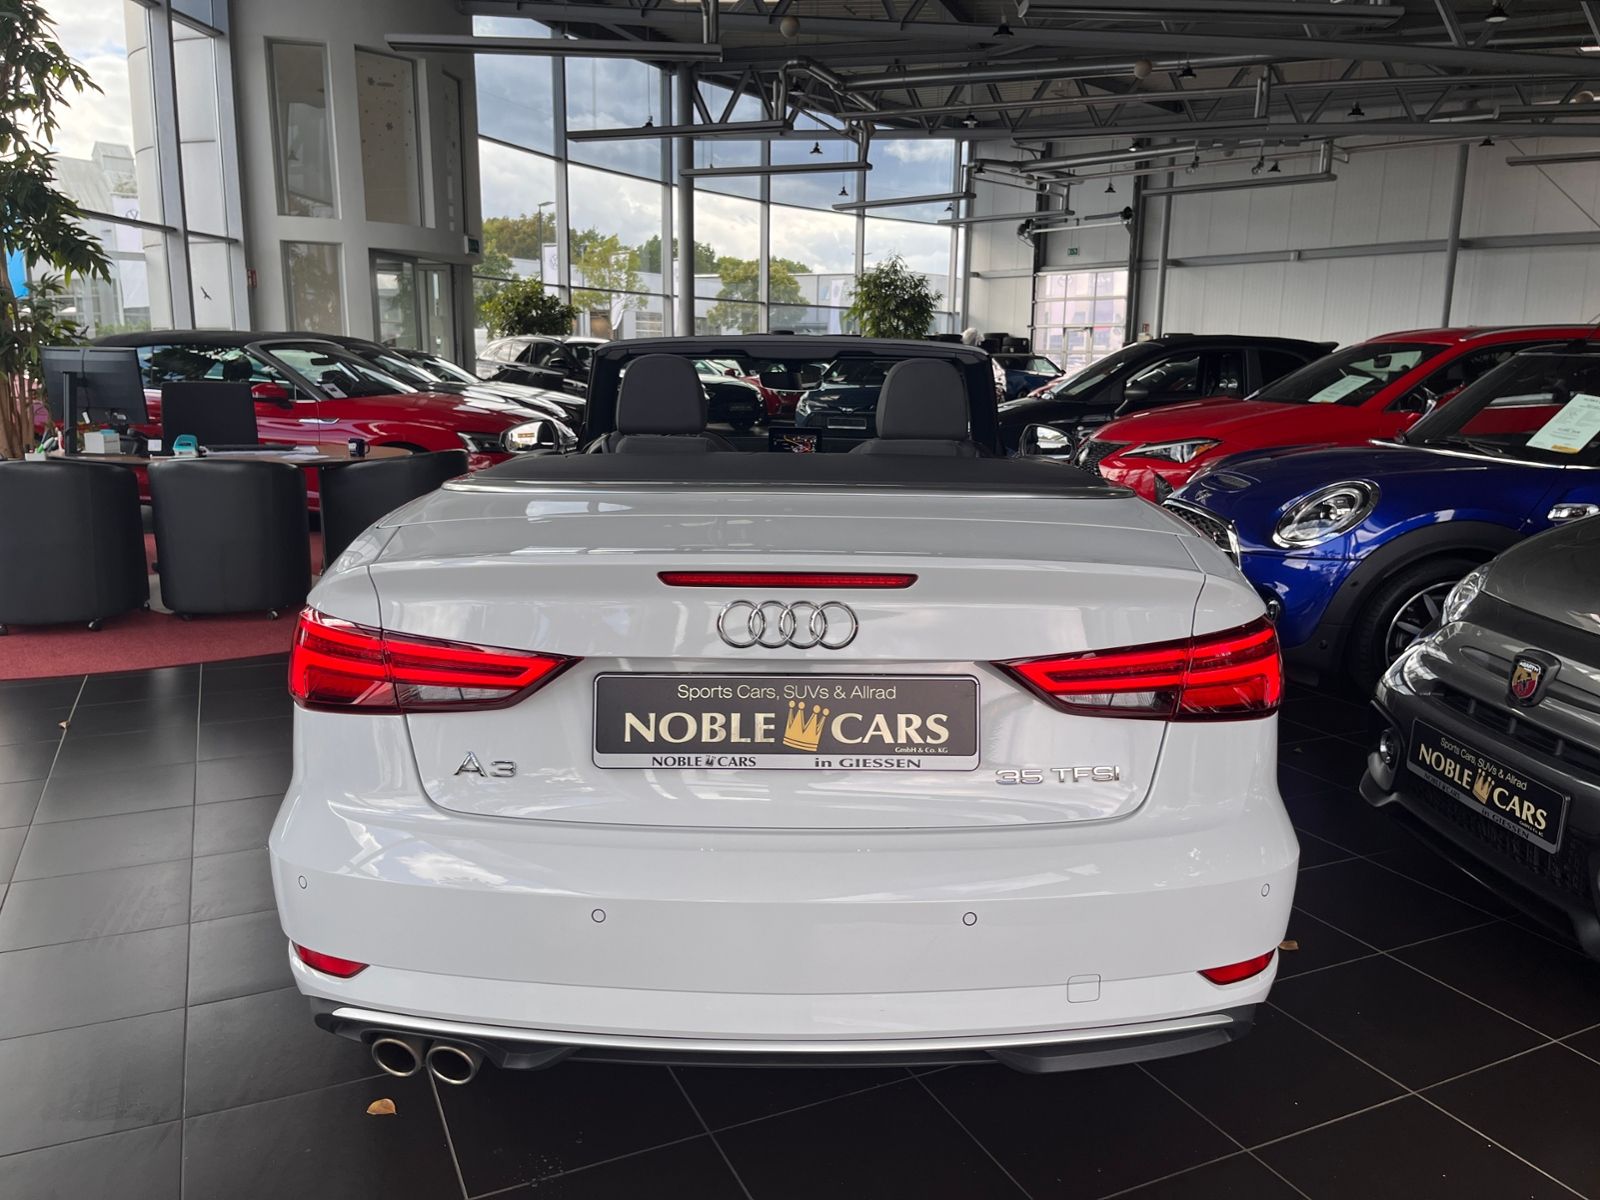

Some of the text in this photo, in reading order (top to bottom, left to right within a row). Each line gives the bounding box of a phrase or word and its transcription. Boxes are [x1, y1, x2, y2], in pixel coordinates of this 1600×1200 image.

[677, 684, 897, 701] Sports Cars, SUVs & Allrad
[624, 711, 950, 745] NOBLE CARS
[453, 750, 517, 778] A3
[652, 756, 757, 767] NOBLE CARS
[814, 757, 921, 769] in GIESSEN
[1440, 737, 1460, 755] Sports
[1476, 758, 1497, 776] SUVs
[1504, 773, 1528, 791] Allrad
[995, 766, 1120, 785] 35 TFSI
[1419, 743, 1473, 790] NOBLE
[1492, 787, 1548, 830] CARS
[1492, 814, 1530, 839] GIESSEN
